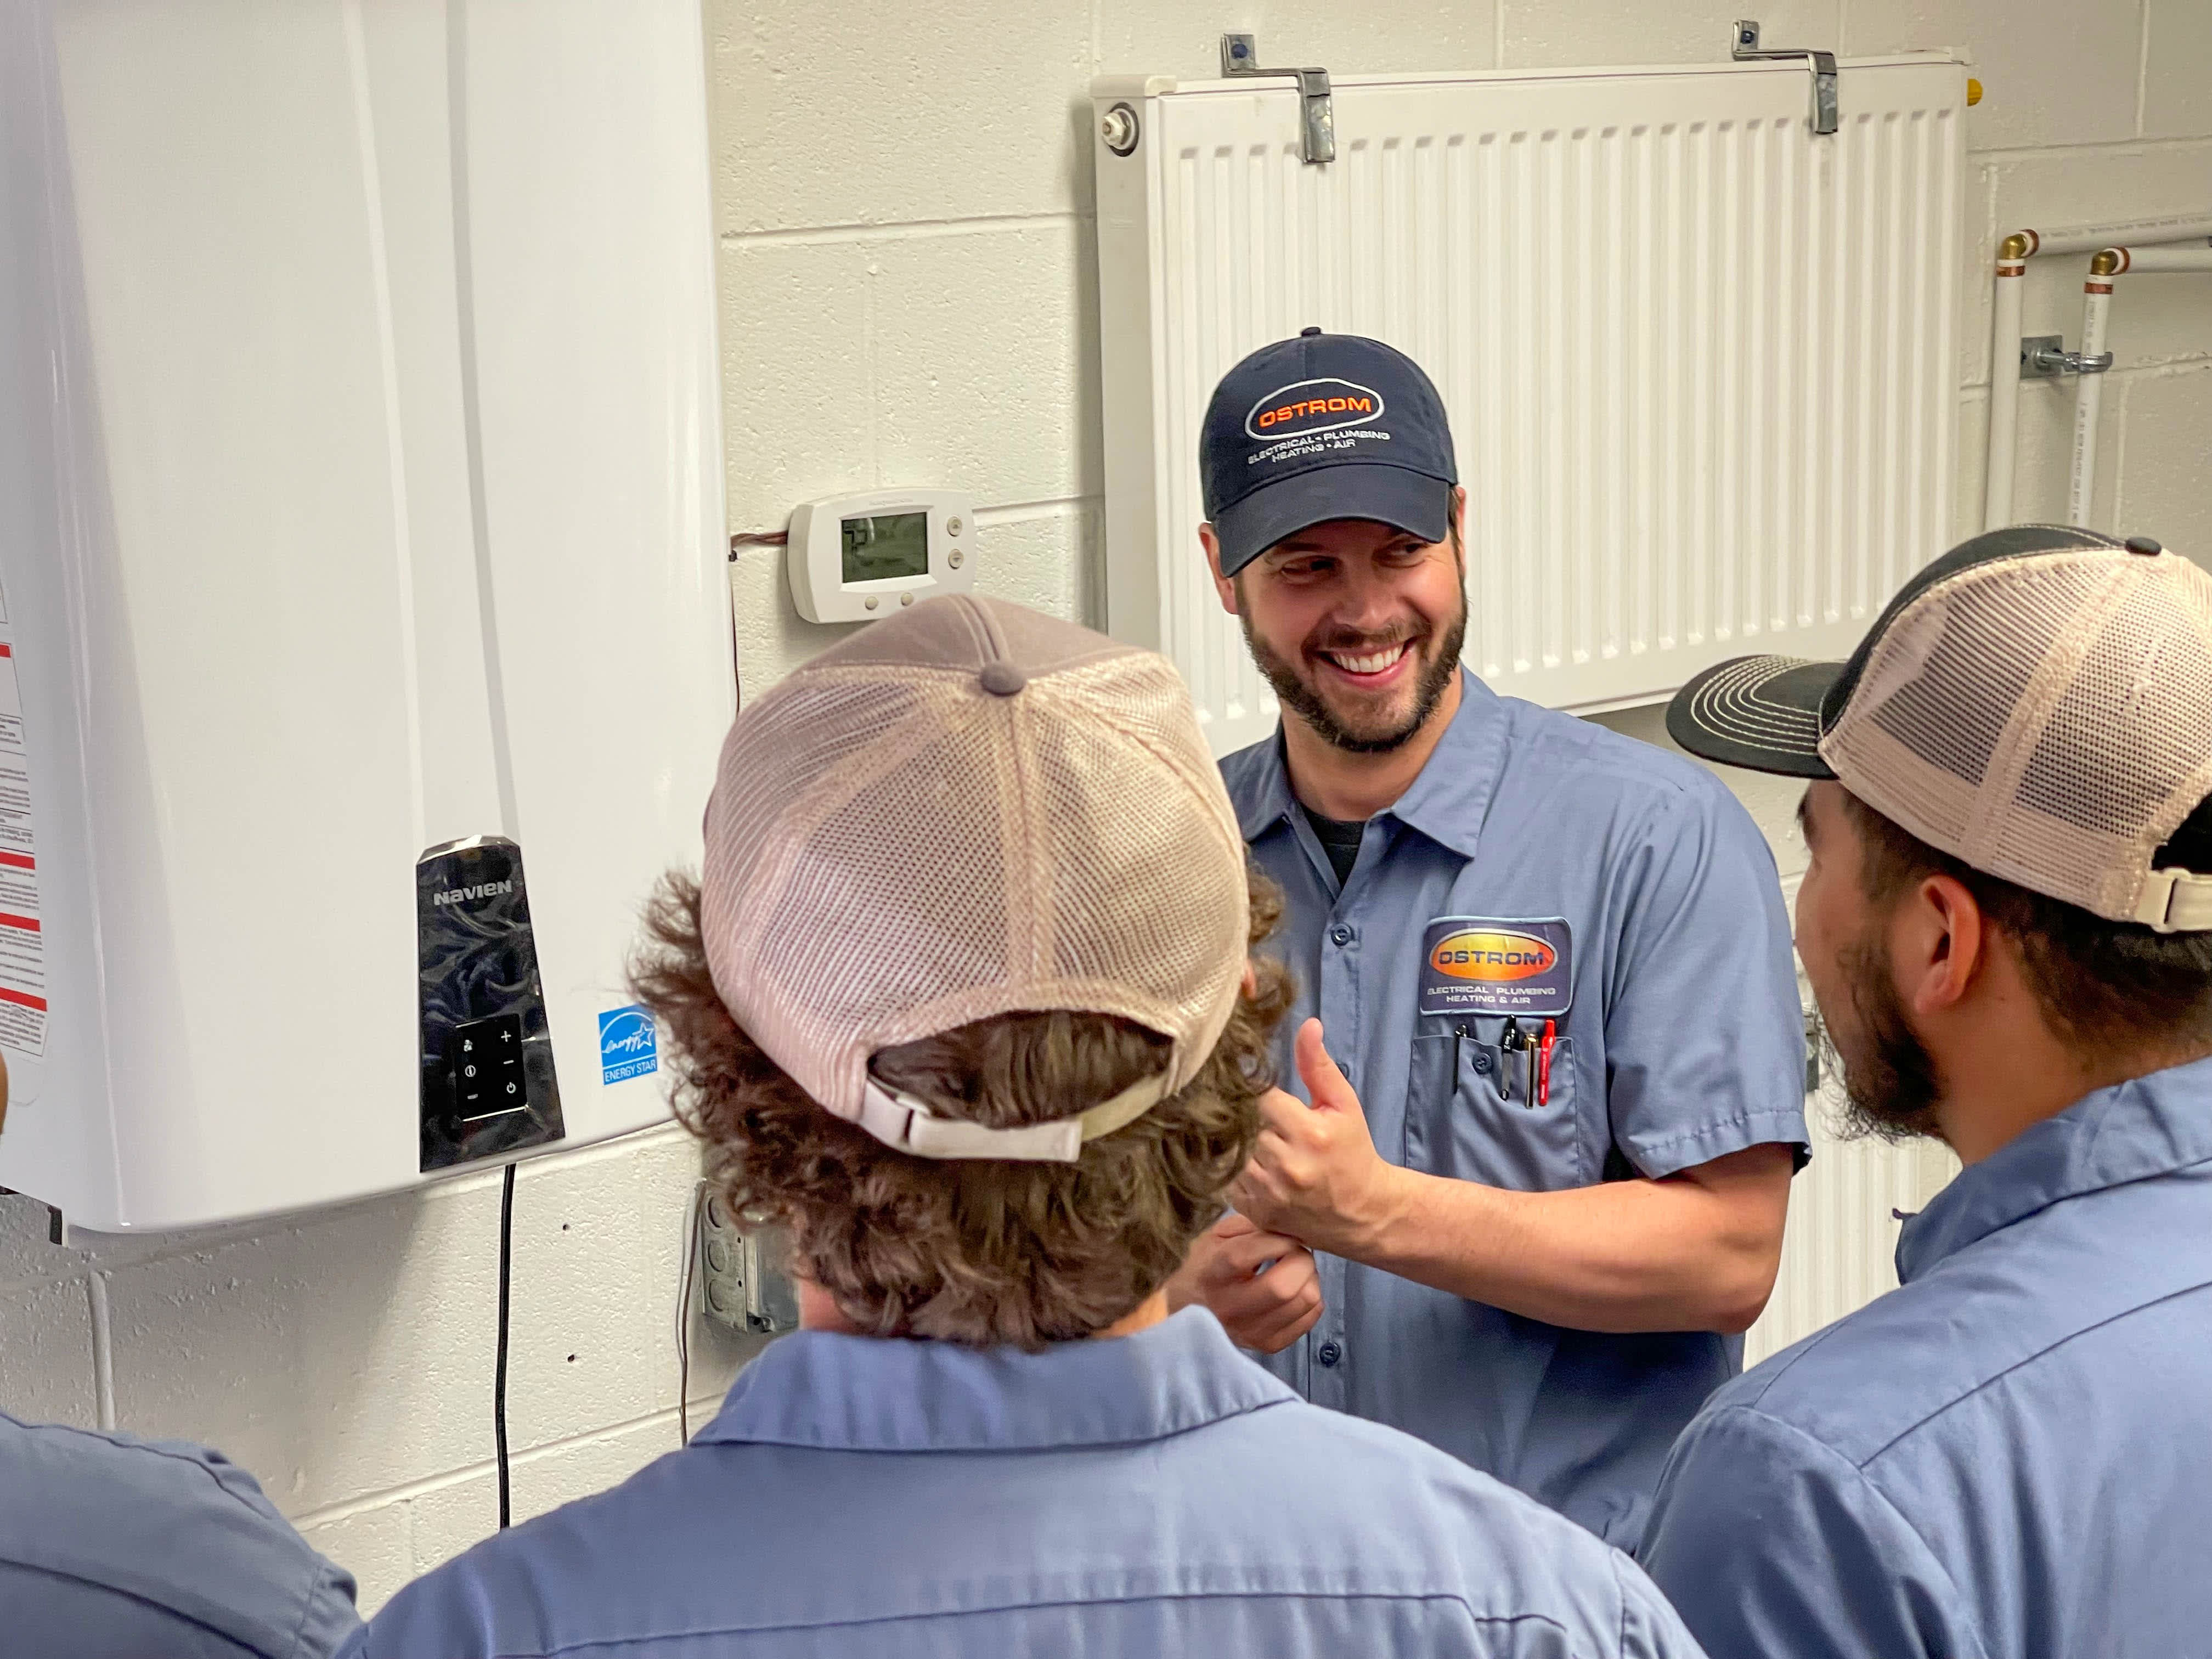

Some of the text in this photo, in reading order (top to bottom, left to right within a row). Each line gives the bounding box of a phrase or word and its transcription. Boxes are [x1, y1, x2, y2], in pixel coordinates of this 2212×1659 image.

[1259, 397, 1372, 427] OSTROM
[1248, 430, 1391, 464] ELECTRICAL PLUMBING
[1272, 438, 1356, 463] HEATING AIR
[1439, 951, 1543, 965] OSTROM
[1427, 986, 1556, 995] ELECTRICAL PLUMBING
[1446, 995, 1531, 1004] HEATING & AIR
[604, 1059, 656, 1082] ENERGY STAR
